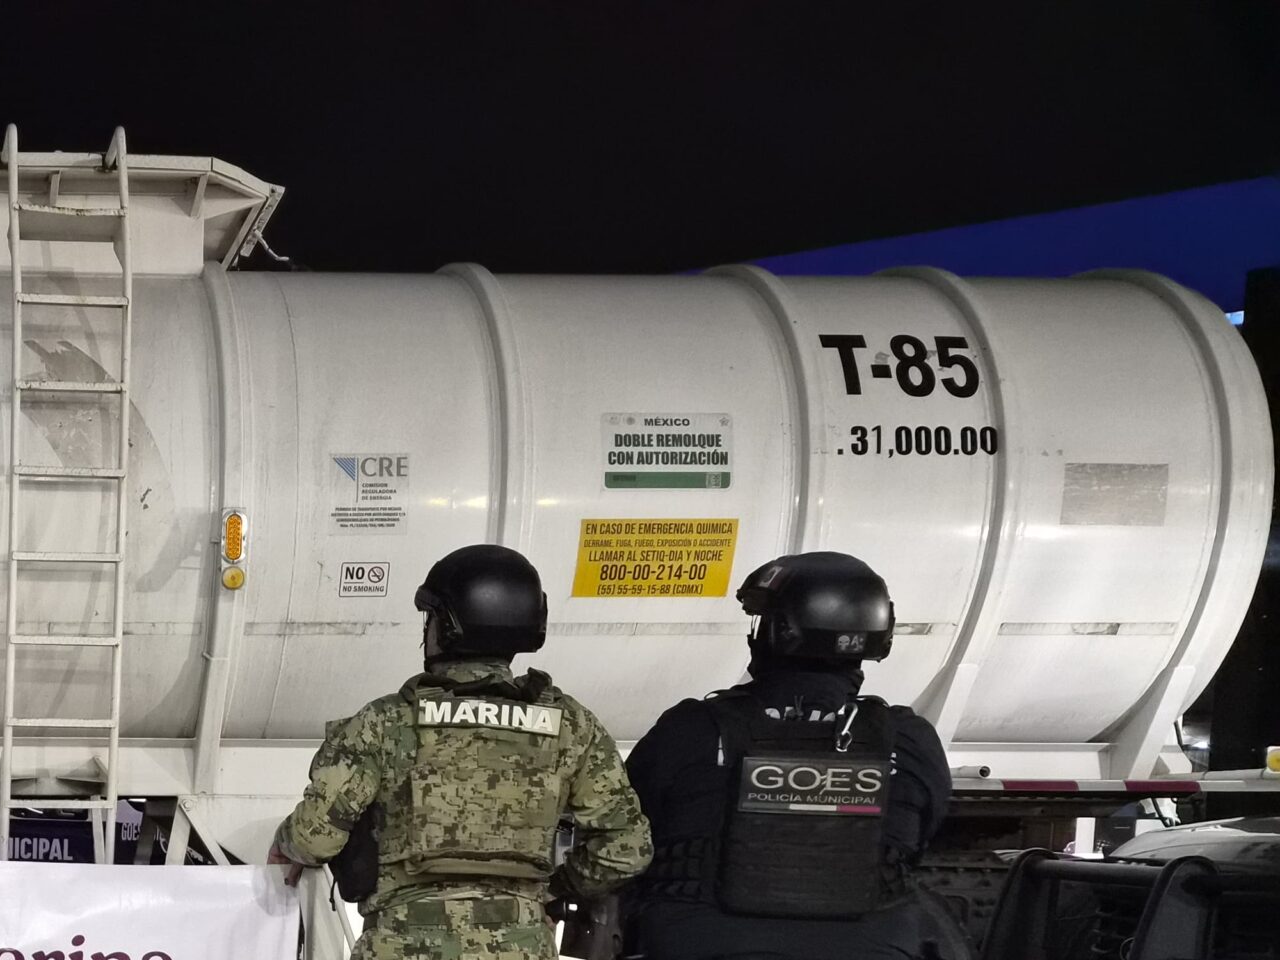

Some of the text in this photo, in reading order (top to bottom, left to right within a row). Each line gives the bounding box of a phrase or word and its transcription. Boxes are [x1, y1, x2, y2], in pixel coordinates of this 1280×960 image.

[818, 333, 979, 398] T-85
[644, 417, 690, 427] MÉXICO
[614, 433, 722, 448] DOBLE REMOLQUE
[608, 449, 728, 466] CON AUTORIZACIÓN
[360, 456, 408, 477] CRE
[586, 522, 733, 535] EN CASO DE EMERGENCIA QUIMICA
[698, 539, 732, 547] ACCIDENTE
[588, 550, 723, 562] LLAMAR AL SETIQ-DIA Y NOCHE
[344, 566, 365, 580] NO
[599, 564, 707, 581] 800-00-214-00
[617, 584, 670, 595] 55-59-15-88
[423, 700, 553, 732] MARINA
[751, 765, 882, 793] GOES
